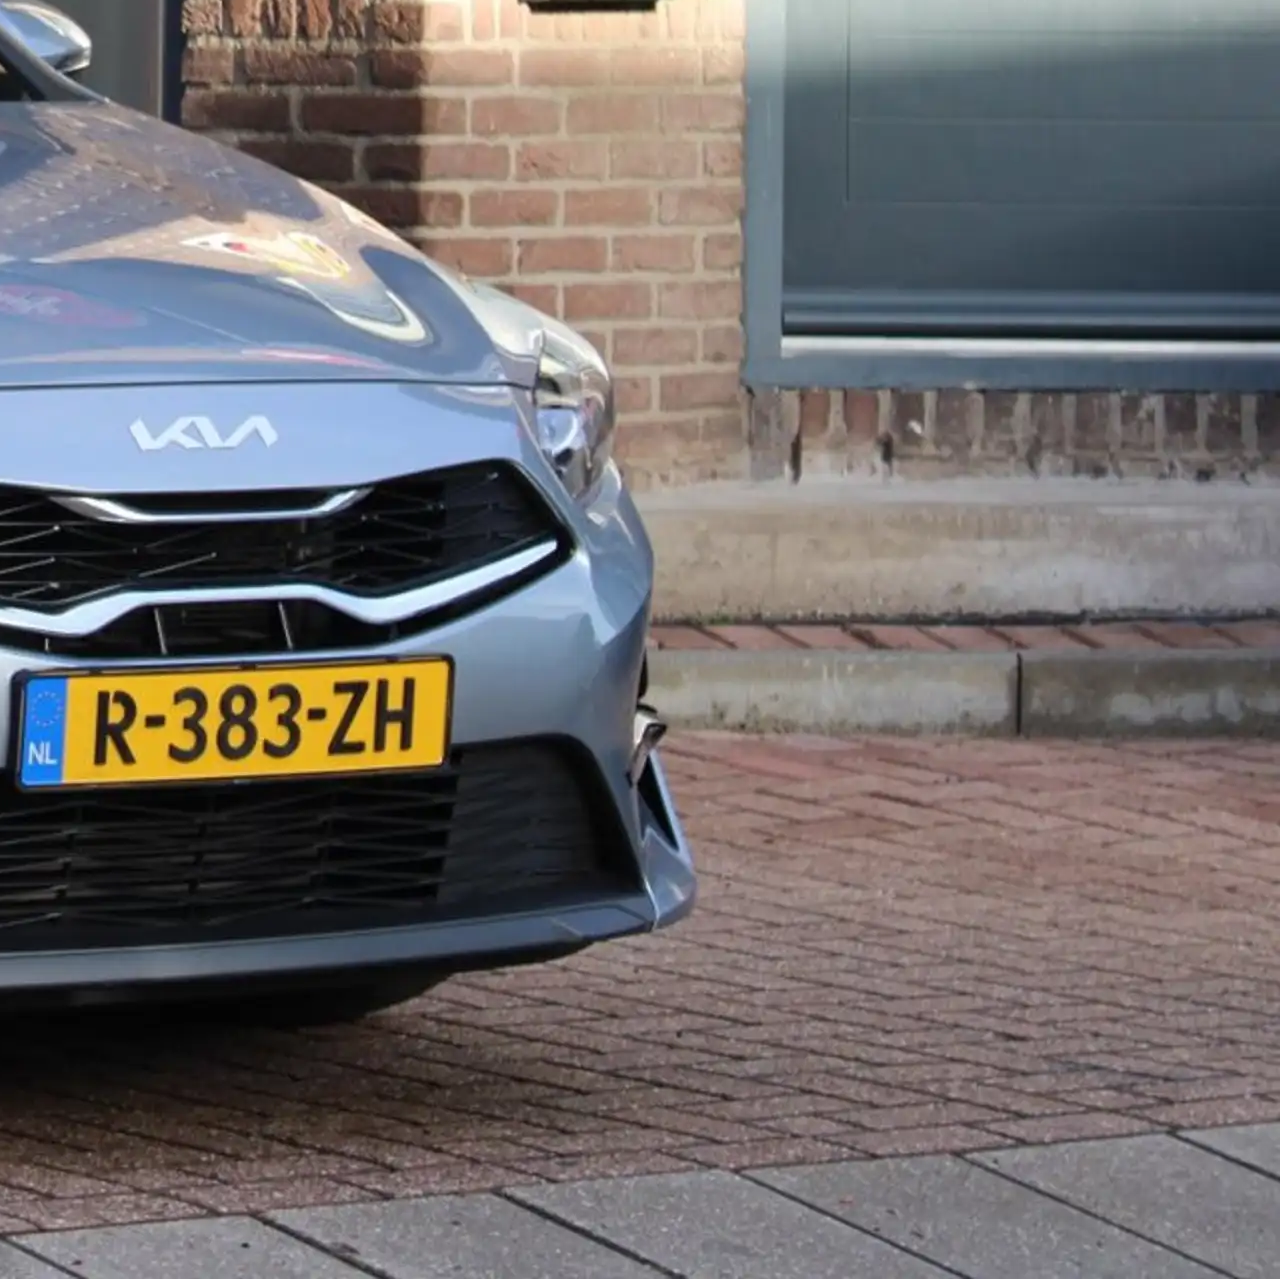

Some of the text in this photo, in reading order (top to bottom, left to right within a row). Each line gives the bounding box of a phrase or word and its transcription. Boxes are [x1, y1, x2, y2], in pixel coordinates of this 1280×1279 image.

[129, 415, 278, 451] KIA
[93, 677, 414, 767] R-383-ZH
[28, 740, 58, 766] NL
